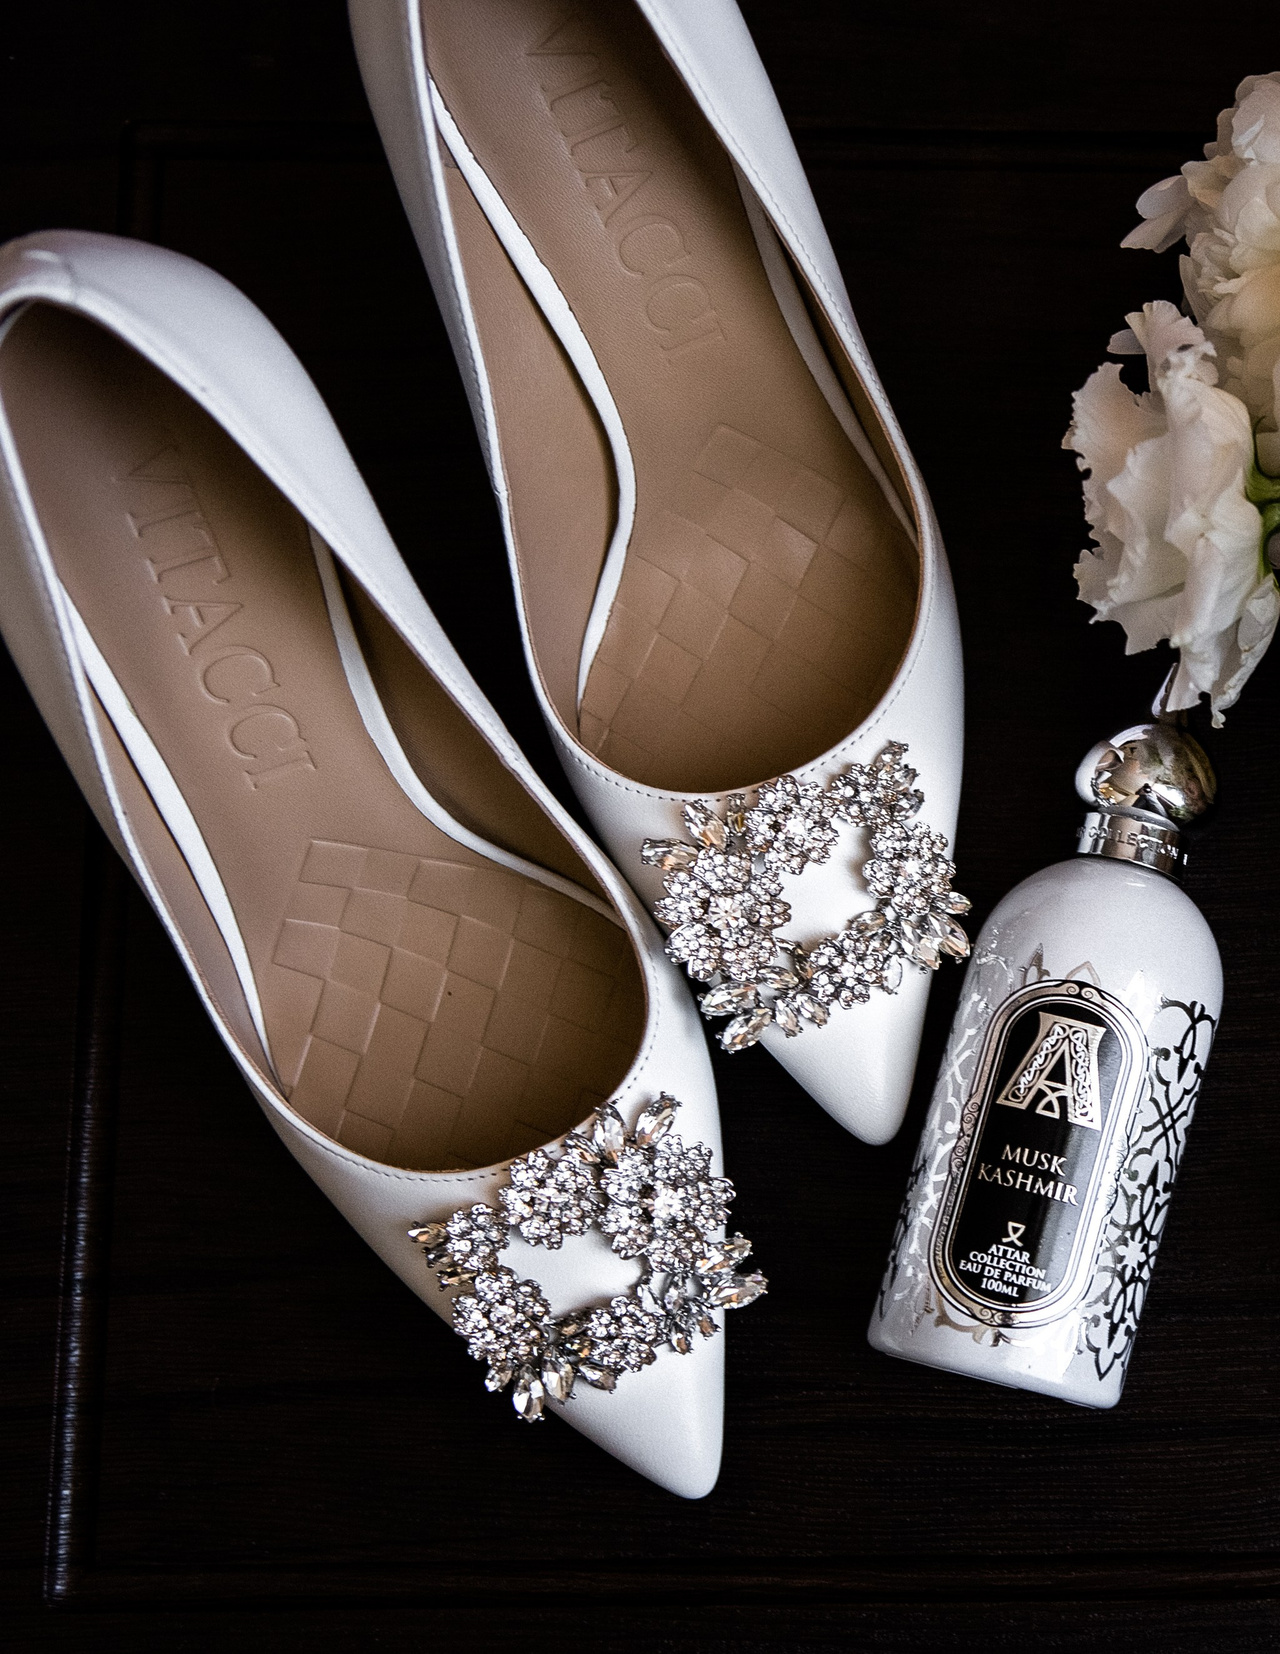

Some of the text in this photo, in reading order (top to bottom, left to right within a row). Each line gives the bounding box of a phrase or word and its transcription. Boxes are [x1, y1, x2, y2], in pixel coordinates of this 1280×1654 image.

[524, 8, 728, 363] VITACCI
[112, 444, 318, 790] VITACCI
[996, 1011, 1106, 1131] A
[1001, 1144, 1067, 1176] MUSK
[977, 1163, 1079, 1206] KASHMIR
[969, 1251, 1047, 1279] COLLECTION
[987, 1243, 1031, 1264] ATTAR
[959, 1259, 1052, 1293] EAU DE PARFUM
[980, 1277, 1020, 1297] 100ML
